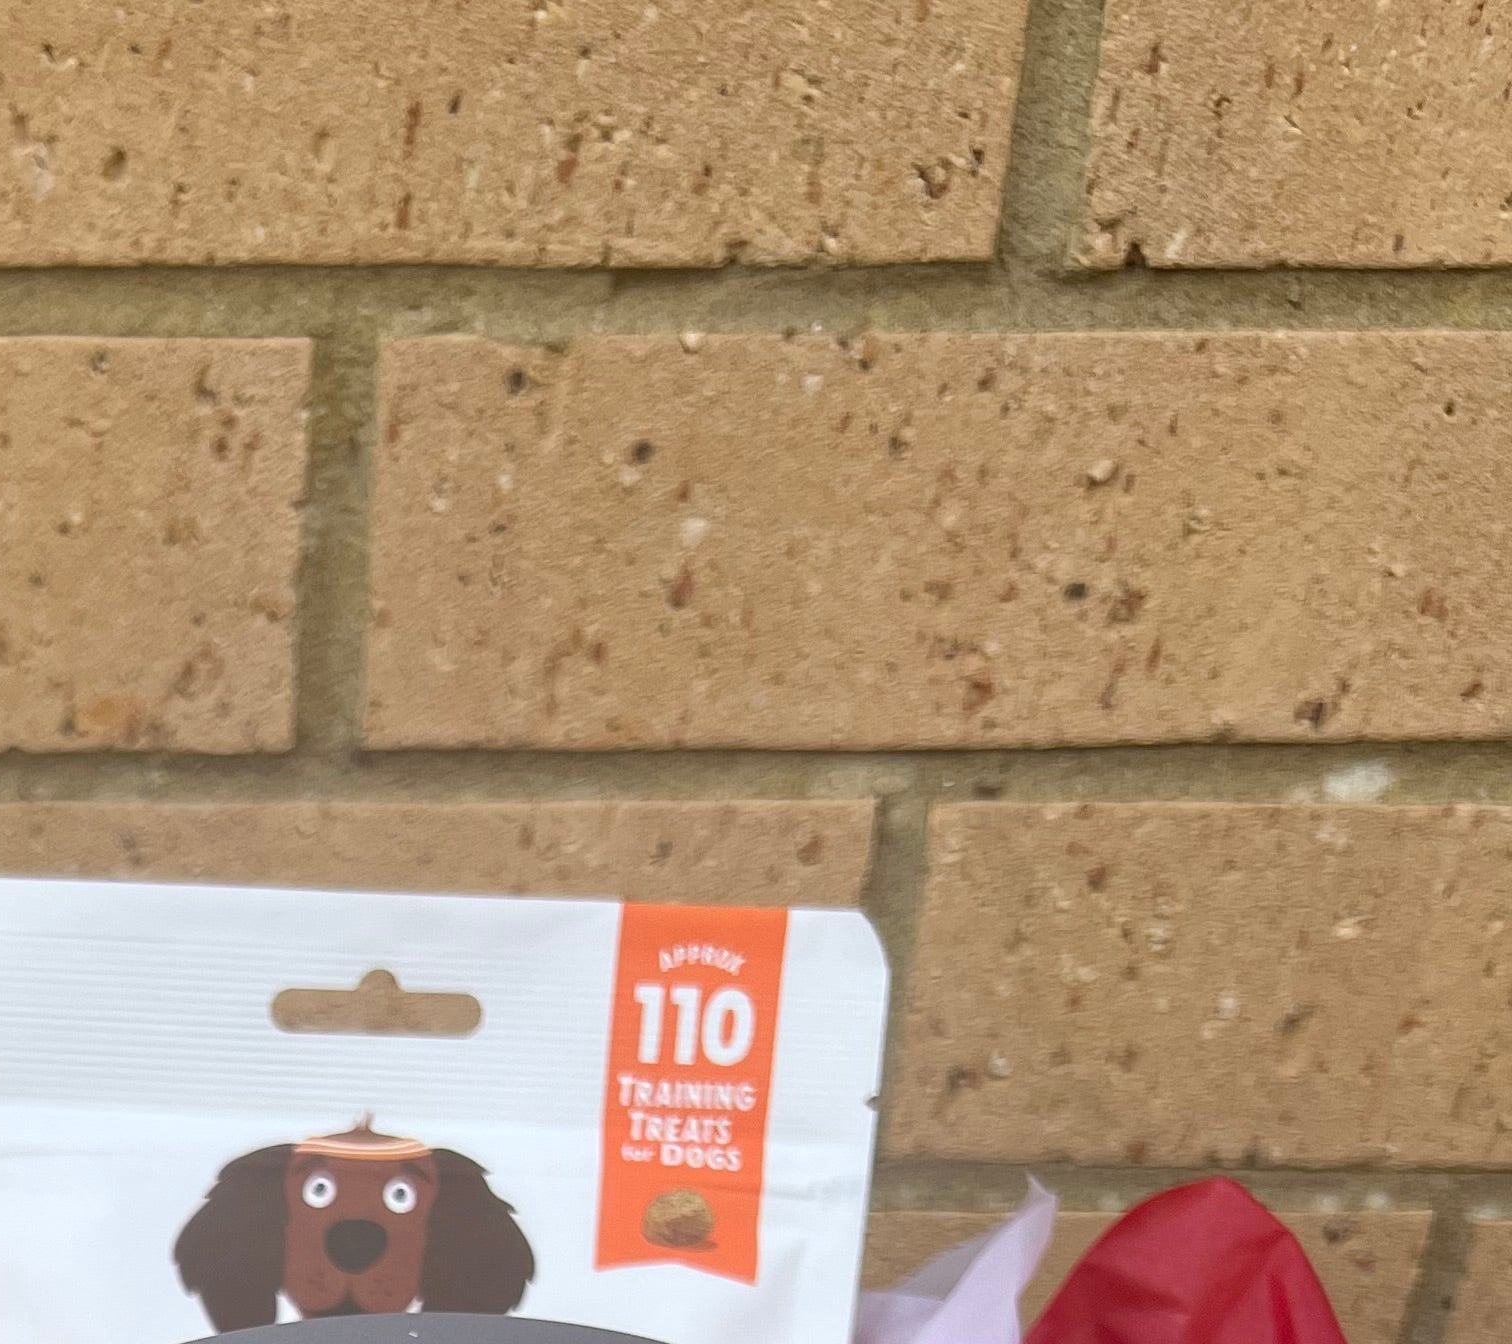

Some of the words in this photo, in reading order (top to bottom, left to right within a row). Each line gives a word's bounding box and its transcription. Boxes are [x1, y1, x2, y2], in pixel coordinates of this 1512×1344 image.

[658, 942, 747, 977] APPROX
[633, 983, 757, 1067] 110
[617, 1073, 757, 1112] TRAINING
[628, 1110, 733, 1145] TREATS
[660, 1143, 743, 1172] DOGS
